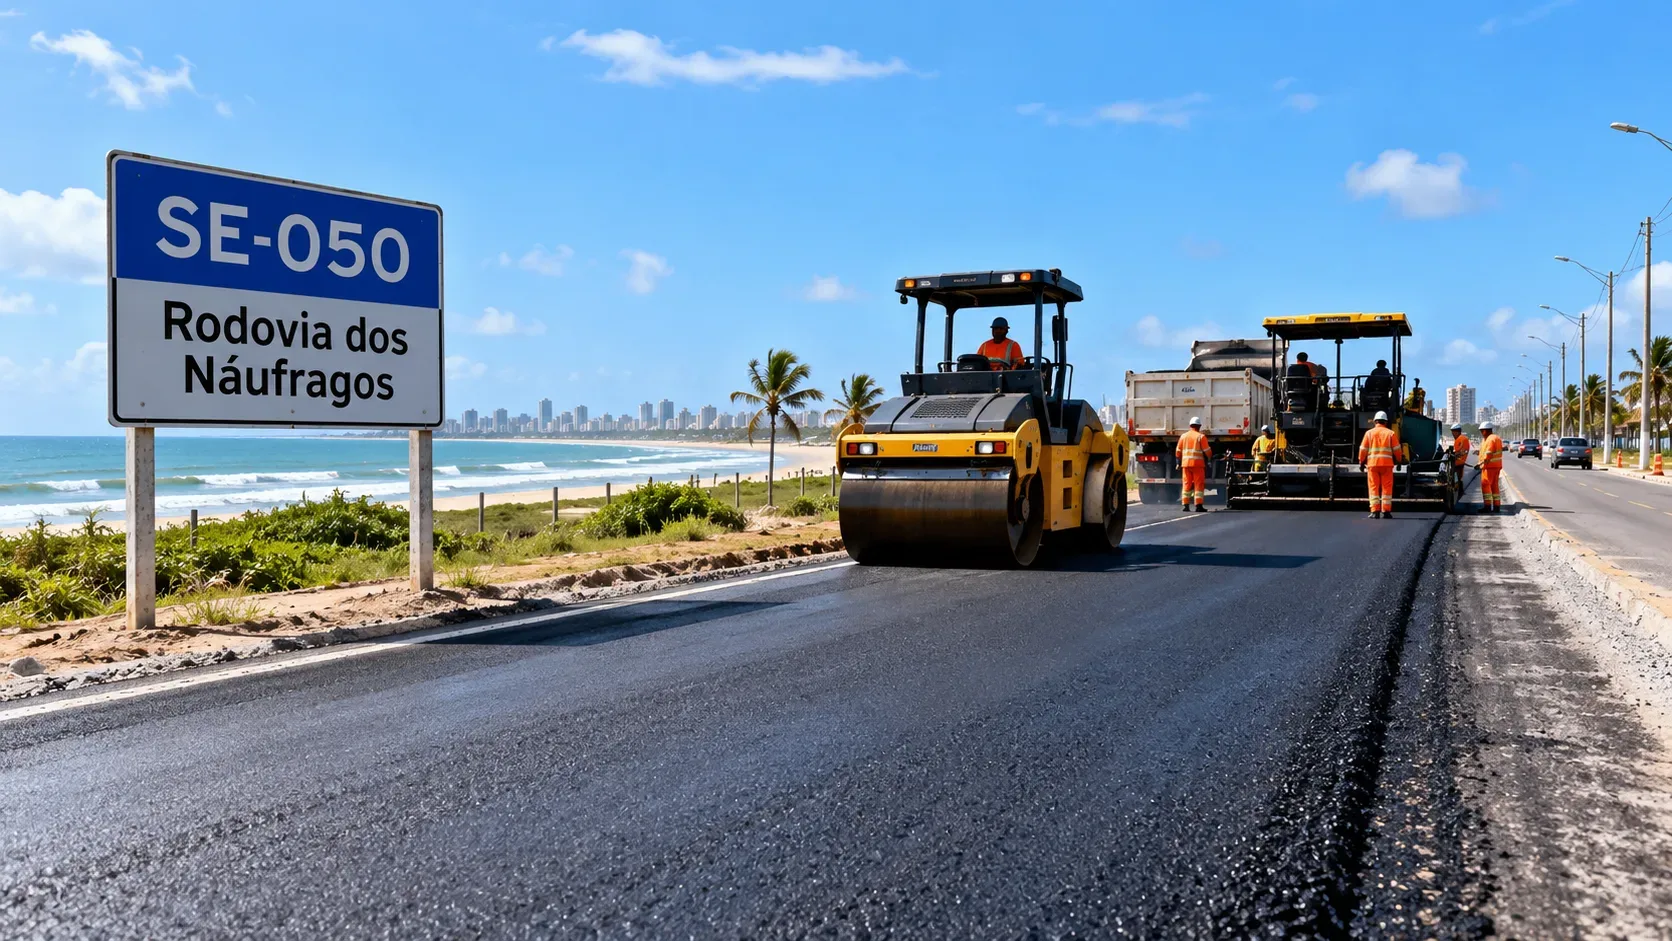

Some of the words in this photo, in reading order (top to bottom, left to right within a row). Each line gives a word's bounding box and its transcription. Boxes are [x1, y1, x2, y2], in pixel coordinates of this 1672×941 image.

[156, 195, 410, 283] SE-050
[164, 300, 332, 350] Rodovia
[346, 317, 408, 356] dos
[185, 354, 394, 408] Náufragos
